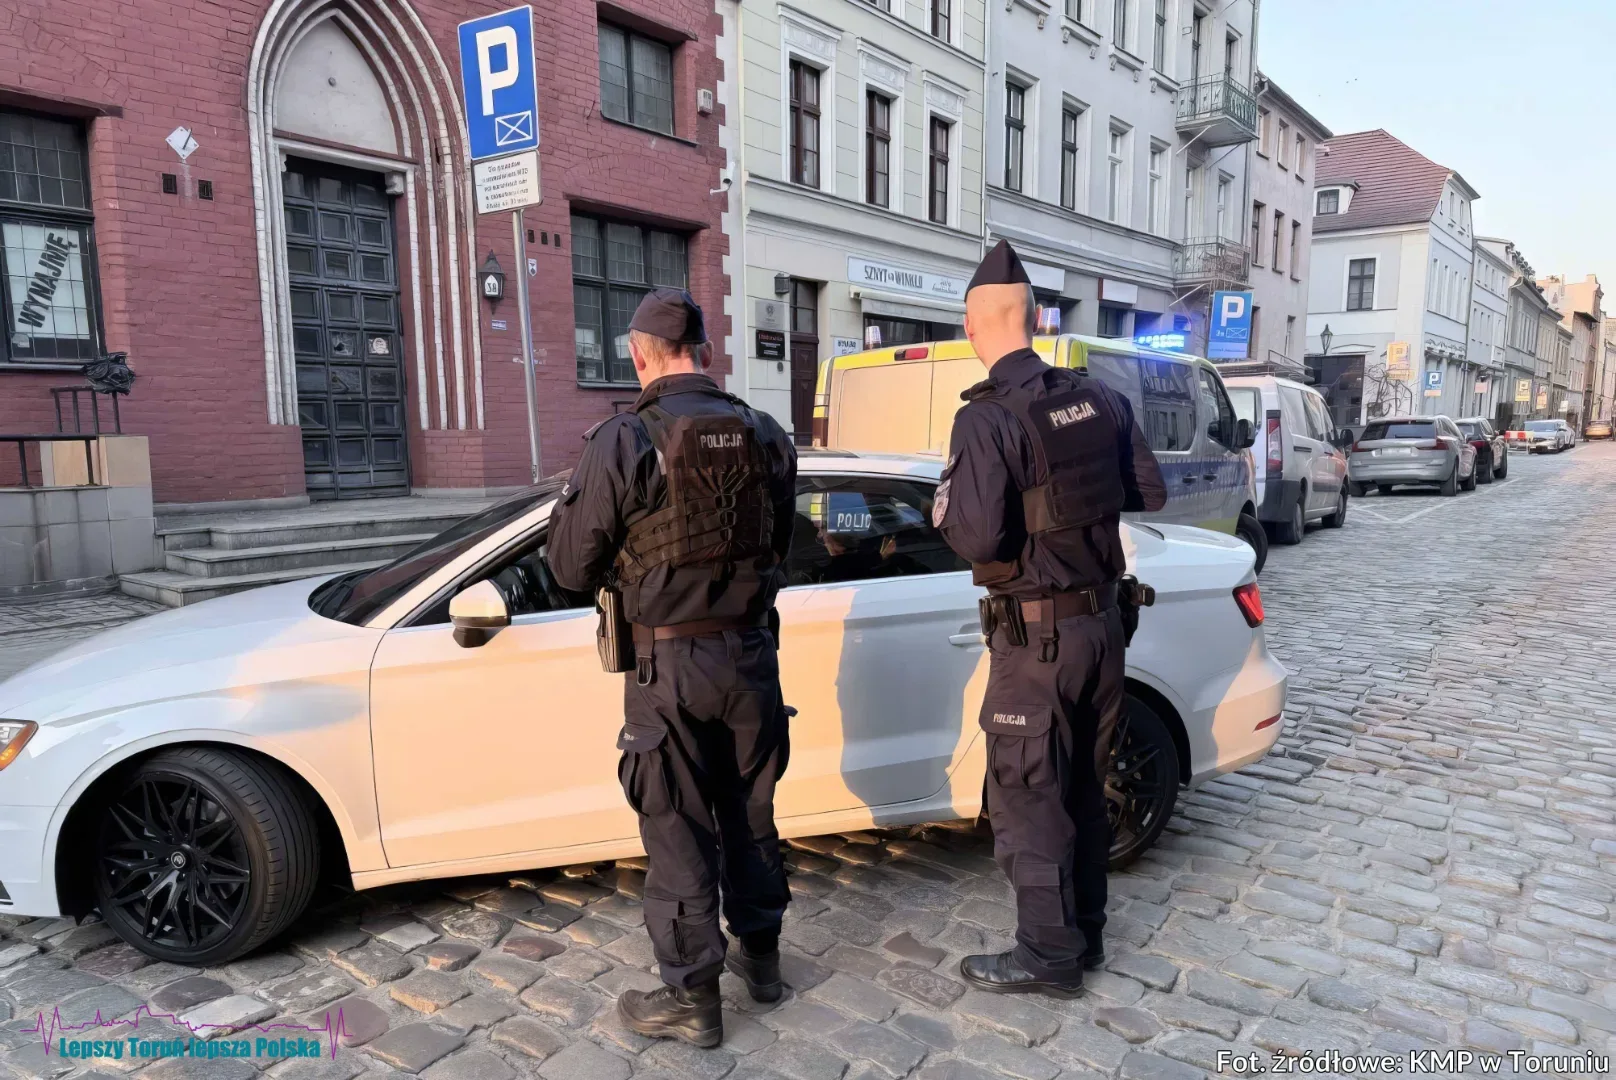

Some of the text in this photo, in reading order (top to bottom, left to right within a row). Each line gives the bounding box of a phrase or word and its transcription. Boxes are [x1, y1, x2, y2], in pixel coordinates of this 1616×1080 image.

[476, 25, 519, 116] P
[18, 232, 77, 328] WYNAJMĘ
[864, 265, 888, 283] SZNYT
[1220, 295, 1245, 327] P
[1049, 401, 1096, 427] POLICJA
[700, 433, 744, 449] POLICJA
[993, 713, 1026, 726] POLICJA
